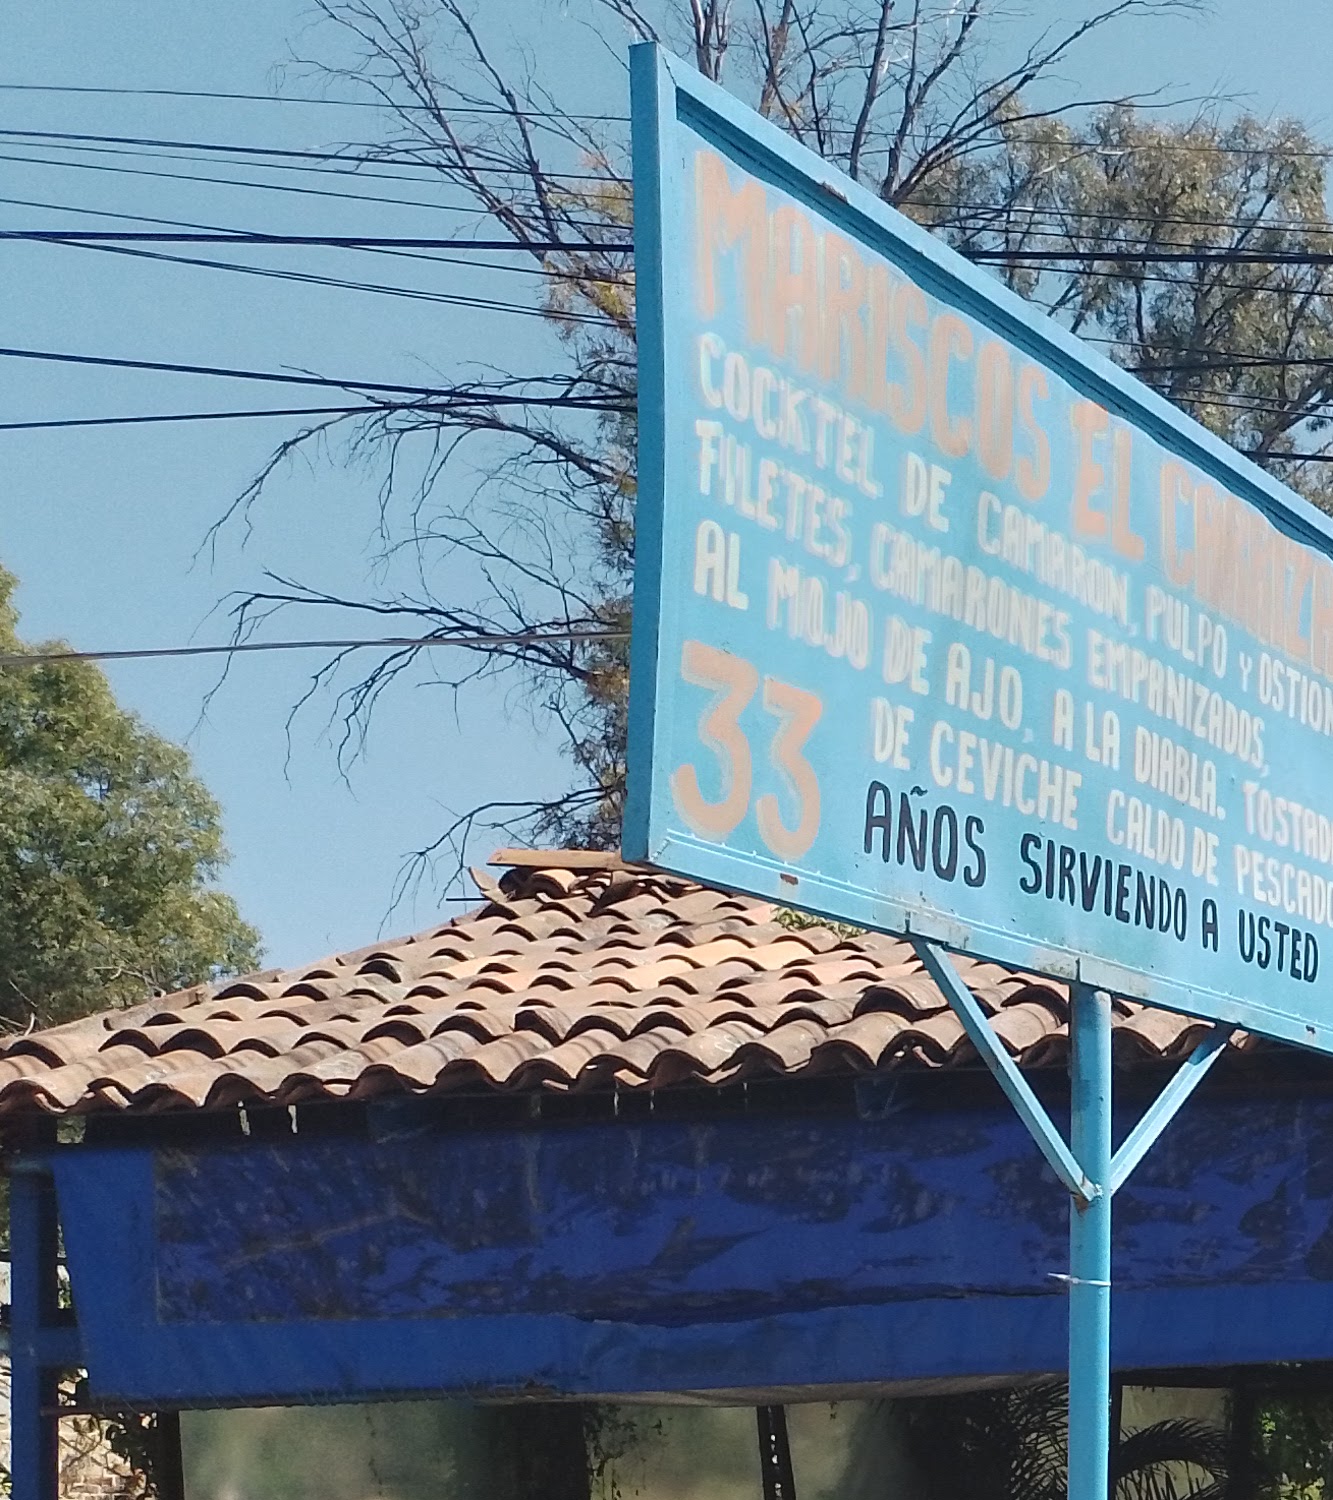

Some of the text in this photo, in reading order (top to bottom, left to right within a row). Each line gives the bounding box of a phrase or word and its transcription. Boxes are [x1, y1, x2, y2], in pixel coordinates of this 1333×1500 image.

[695, 150, 1050, 500] MARISCOS
[1072, 402, 1145, 561] EL
[699, 331, 883, 500] COCKTEL
[906, 451, 952, 533] DE
[1145, 584, 1228, 680] PULPO
[871, 521, 1073, 670] CAMARONES
[669, 640, 823, 861] 33
[694, 519, 749, 611] AL
[766, 557, 871, 671] MOJO
[882, 615, 933, 696] DE
[1053, 688, 1075, 752] A
[1085, 701, 1121, 771] LA
[863, 779, 1320, 983] AÑOS SIRVIENDO A USTED
[872, 697, 915, 771] DE
[930, 720, 1083, 831] CEVICHE
[1106, 789, 1186, 870] CALDO
[1191, 826, 1220, 887] DE
